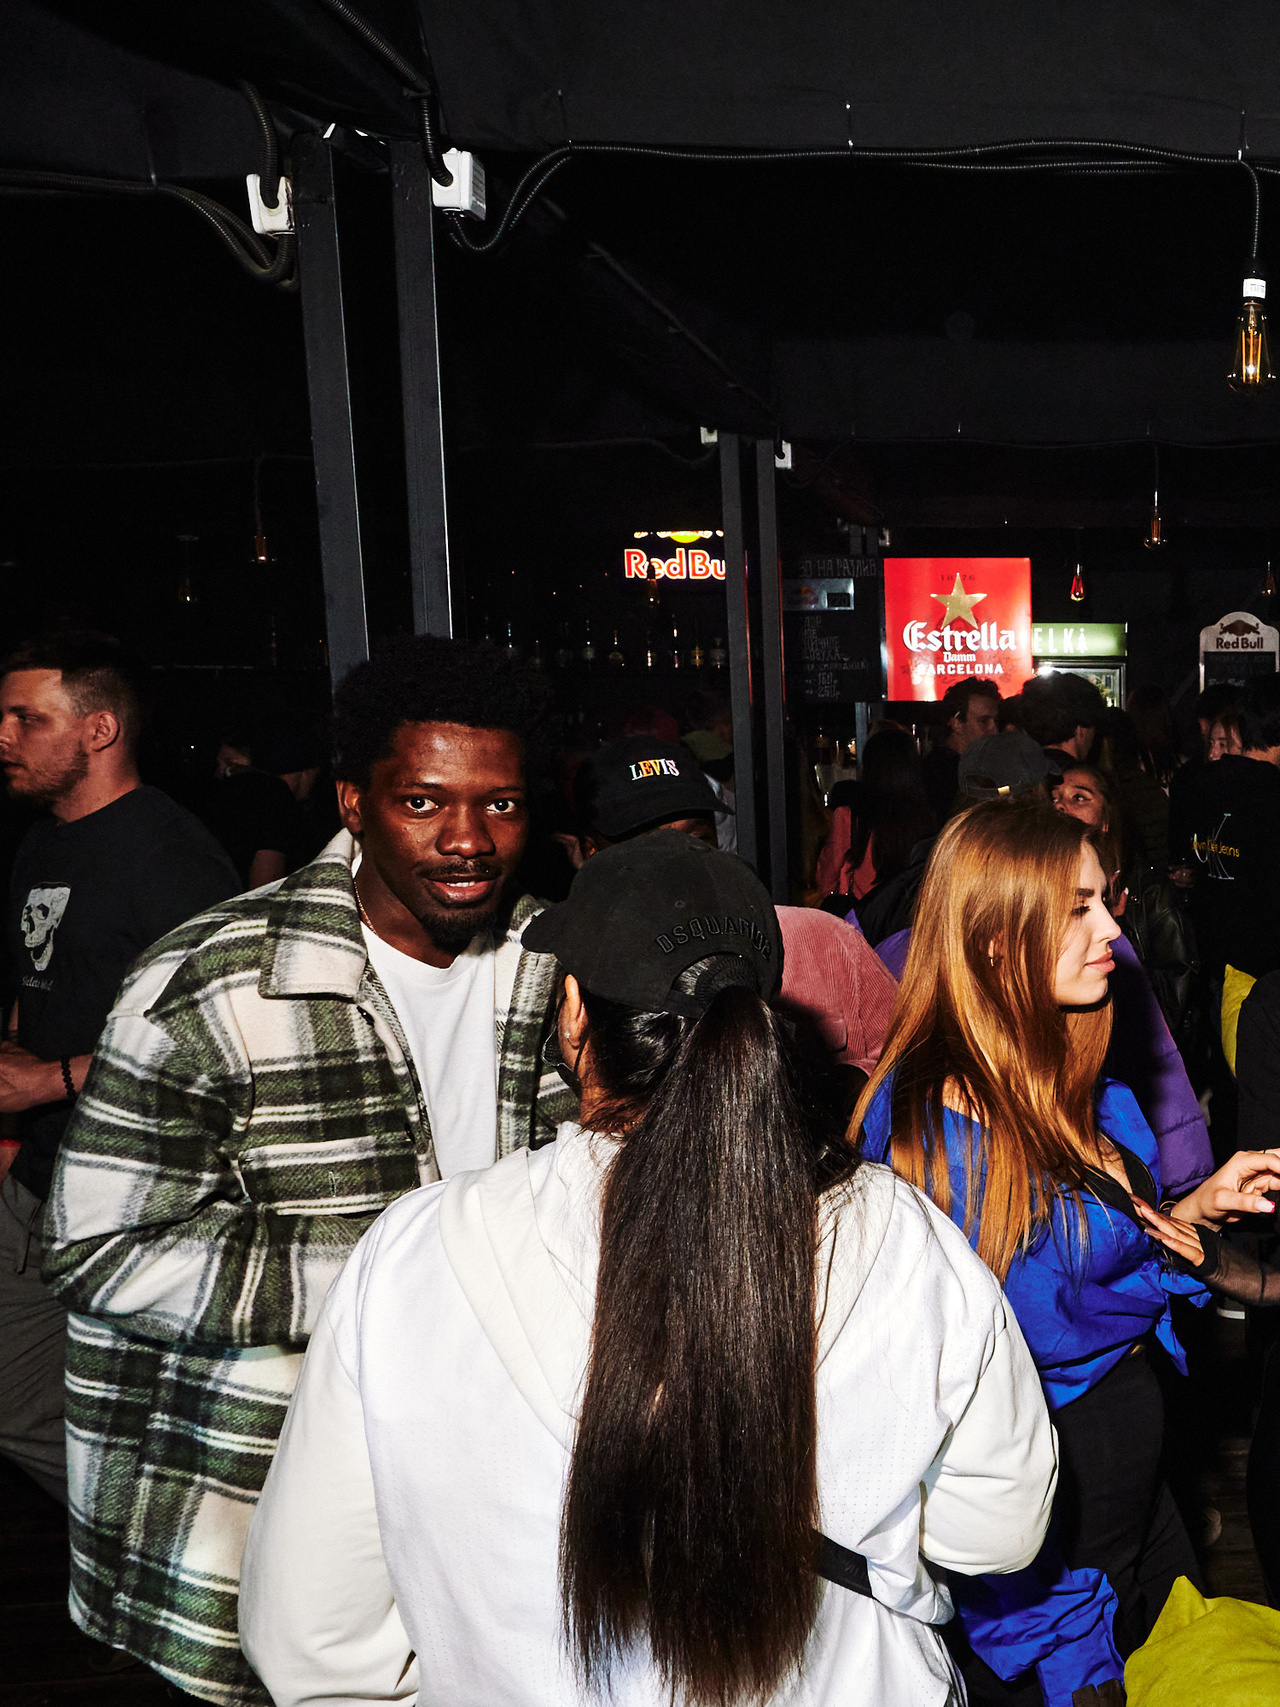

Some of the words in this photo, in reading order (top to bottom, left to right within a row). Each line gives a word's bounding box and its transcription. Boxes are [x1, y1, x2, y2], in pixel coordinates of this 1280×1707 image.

[624, 548, 686, 579] Red
[688, 549, 726, 580] Bu
[903, 620, 1017, 652] Estrella
[1216, 637, 1239, 649] Red
[1241, 637, 1264, 649] Bull
[943, 651, 977, 662] Damm
[917, 663, 1004, 675] BARCELONA
